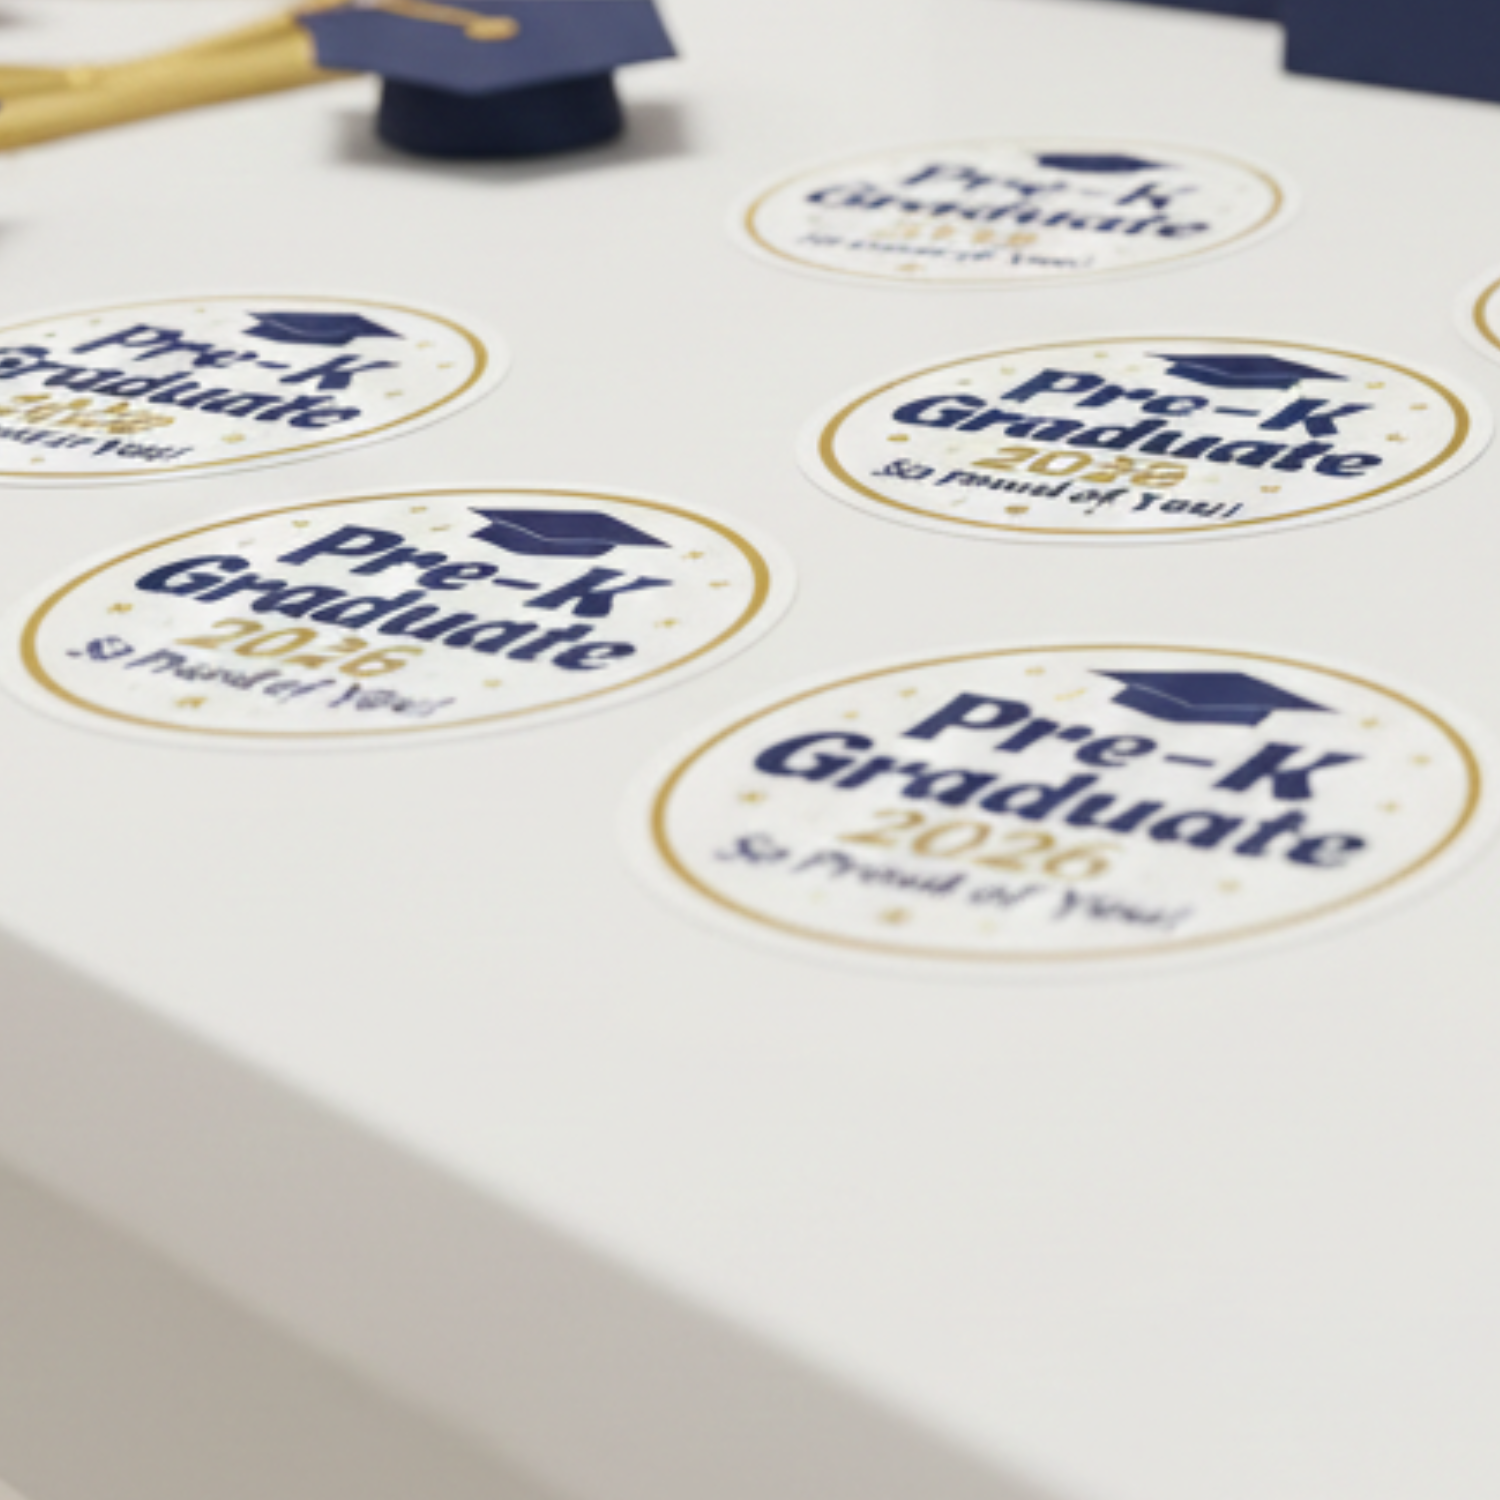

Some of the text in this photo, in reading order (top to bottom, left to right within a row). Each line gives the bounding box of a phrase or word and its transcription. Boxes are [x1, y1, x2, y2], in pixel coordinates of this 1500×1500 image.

[72, 324, 400, 390] Pre-K
[891, 394, 1383, 478] Graduate
[1001, 368, 1375, 438] Pre-K
[134, 554, 636, 671] Graduate
[277, 524, 673, 618] Pre-K
[900, 690, 1363, 801] Pre-K
[752, 728, 1369, 869] Graduate
[836, 808, 1124, 880] 2026
